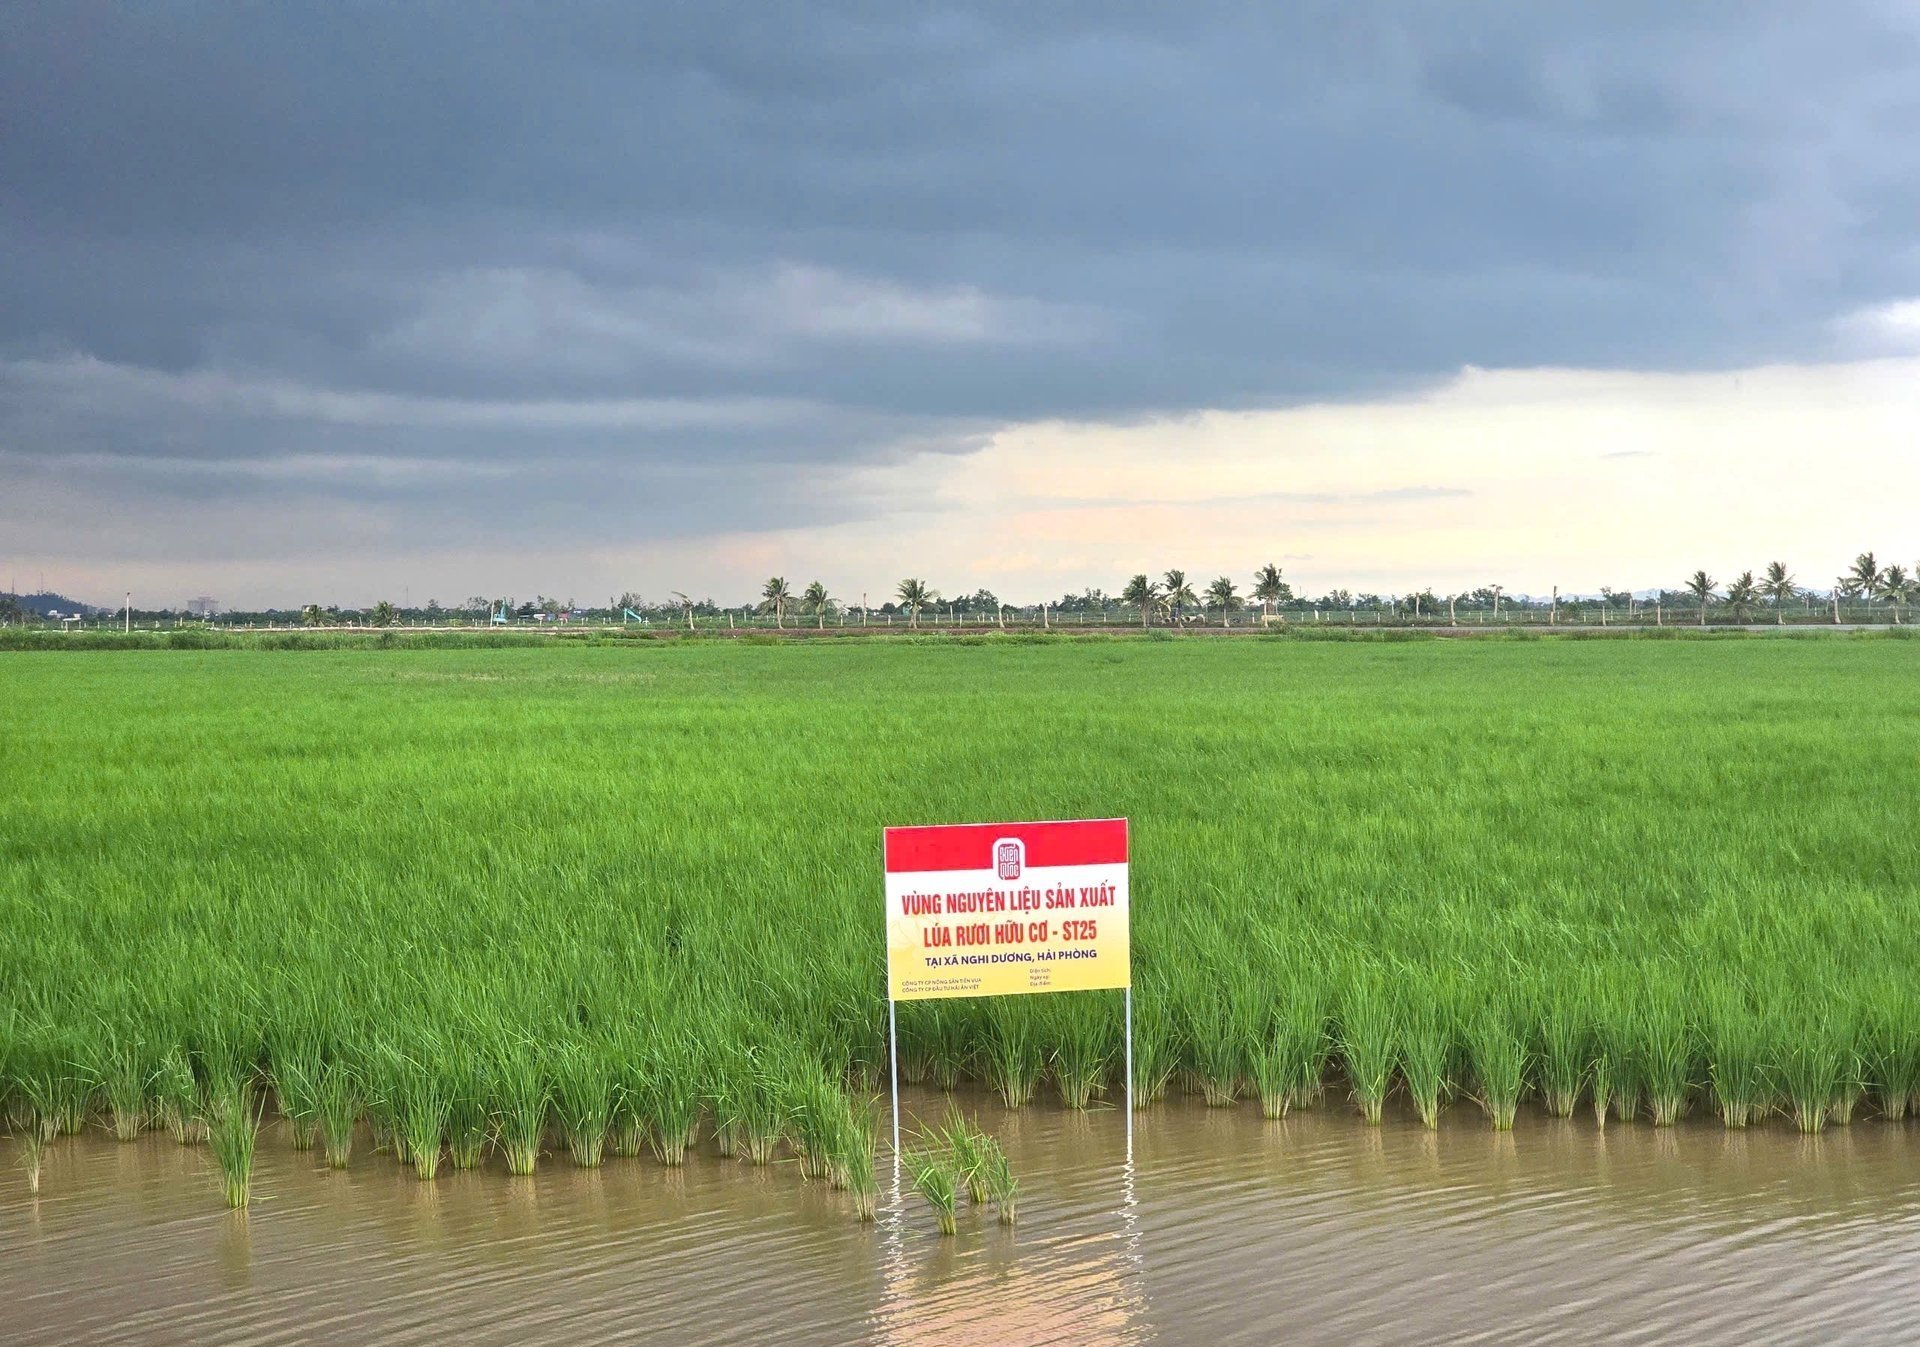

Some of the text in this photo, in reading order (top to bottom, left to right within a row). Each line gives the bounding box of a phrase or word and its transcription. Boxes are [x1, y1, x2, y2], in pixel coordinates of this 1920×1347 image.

[902, 879, 1116, 915] VÙNG NGUYÊN LIỆU SẢN XUẤT
[924, 923, 952, 948] LÚA
[956, 923, 990, 946] RƯƠI
[995, 920, 1024, 944] HỮU
[1028, 920, 1048, 942] CƠ
[1062, 920, 1097, 941] ST25
[925, 948, 1097, 968] TẠI XÃ NGHI DƯƠNG, HẢI PHÒNG
